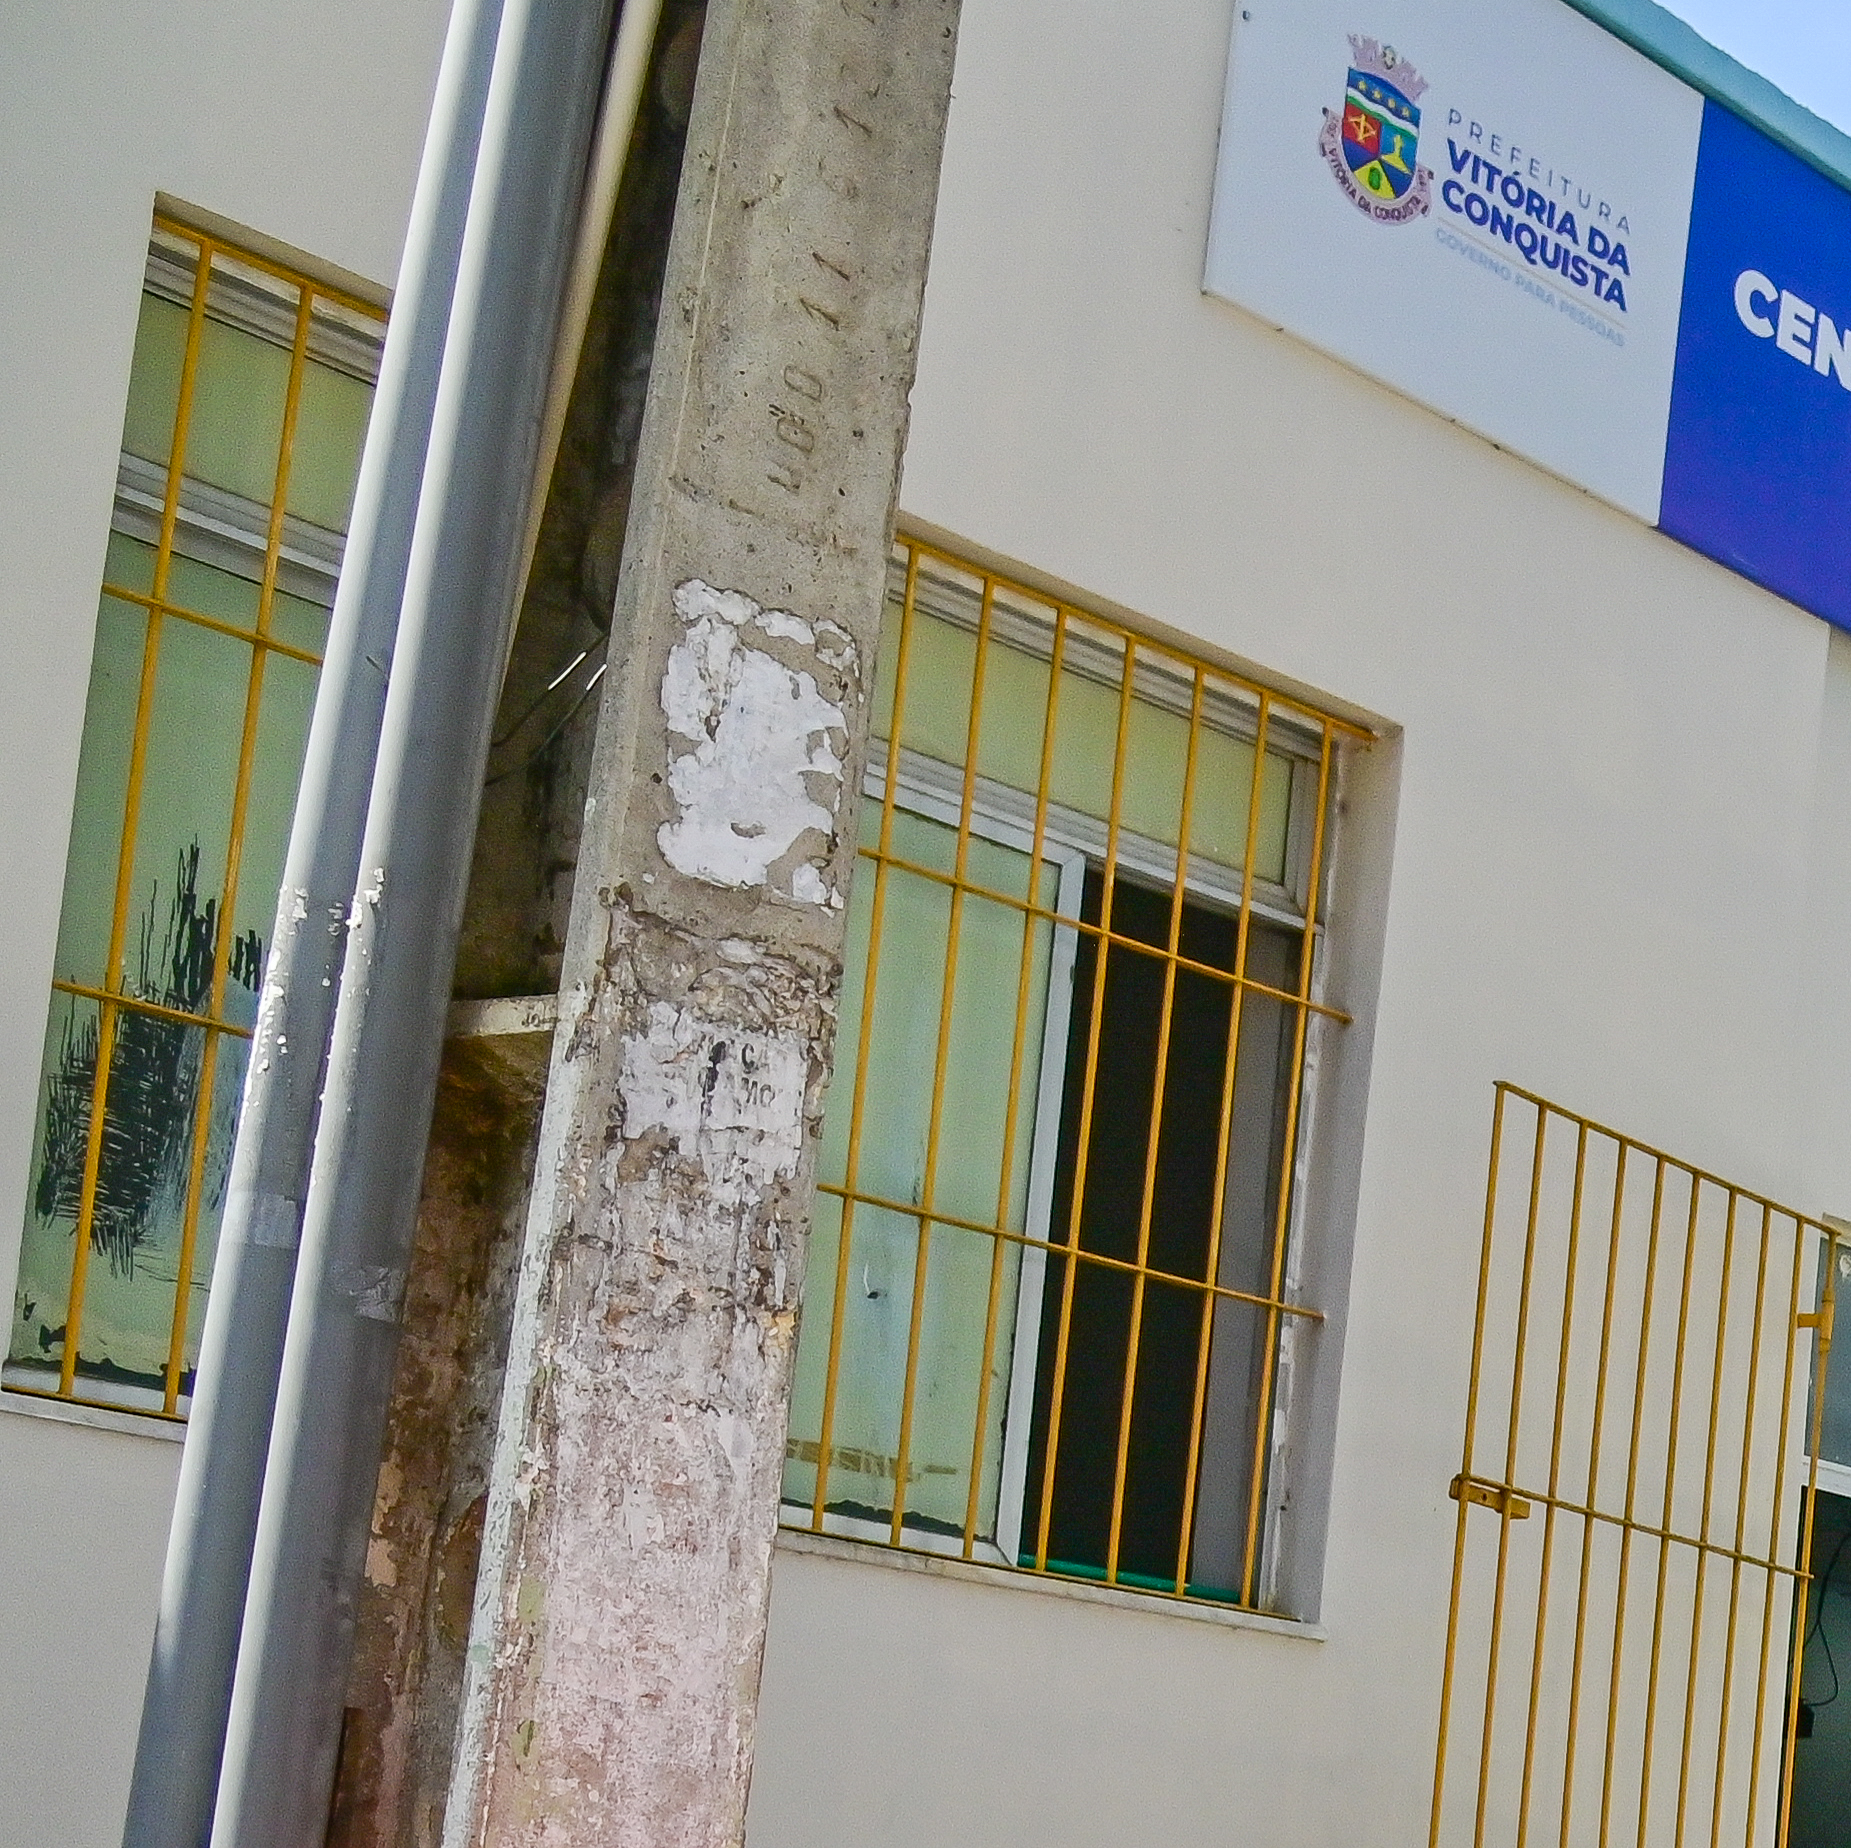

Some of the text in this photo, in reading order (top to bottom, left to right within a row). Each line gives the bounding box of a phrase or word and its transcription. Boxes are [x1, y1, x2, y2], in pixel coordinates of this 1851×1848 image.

[1447, 137, 1631, 276] VITÓRIA DA
[1449, 108, 1631, 235] PREFEITURA
[1442, 179, 1627, 313] CONQUISTA
